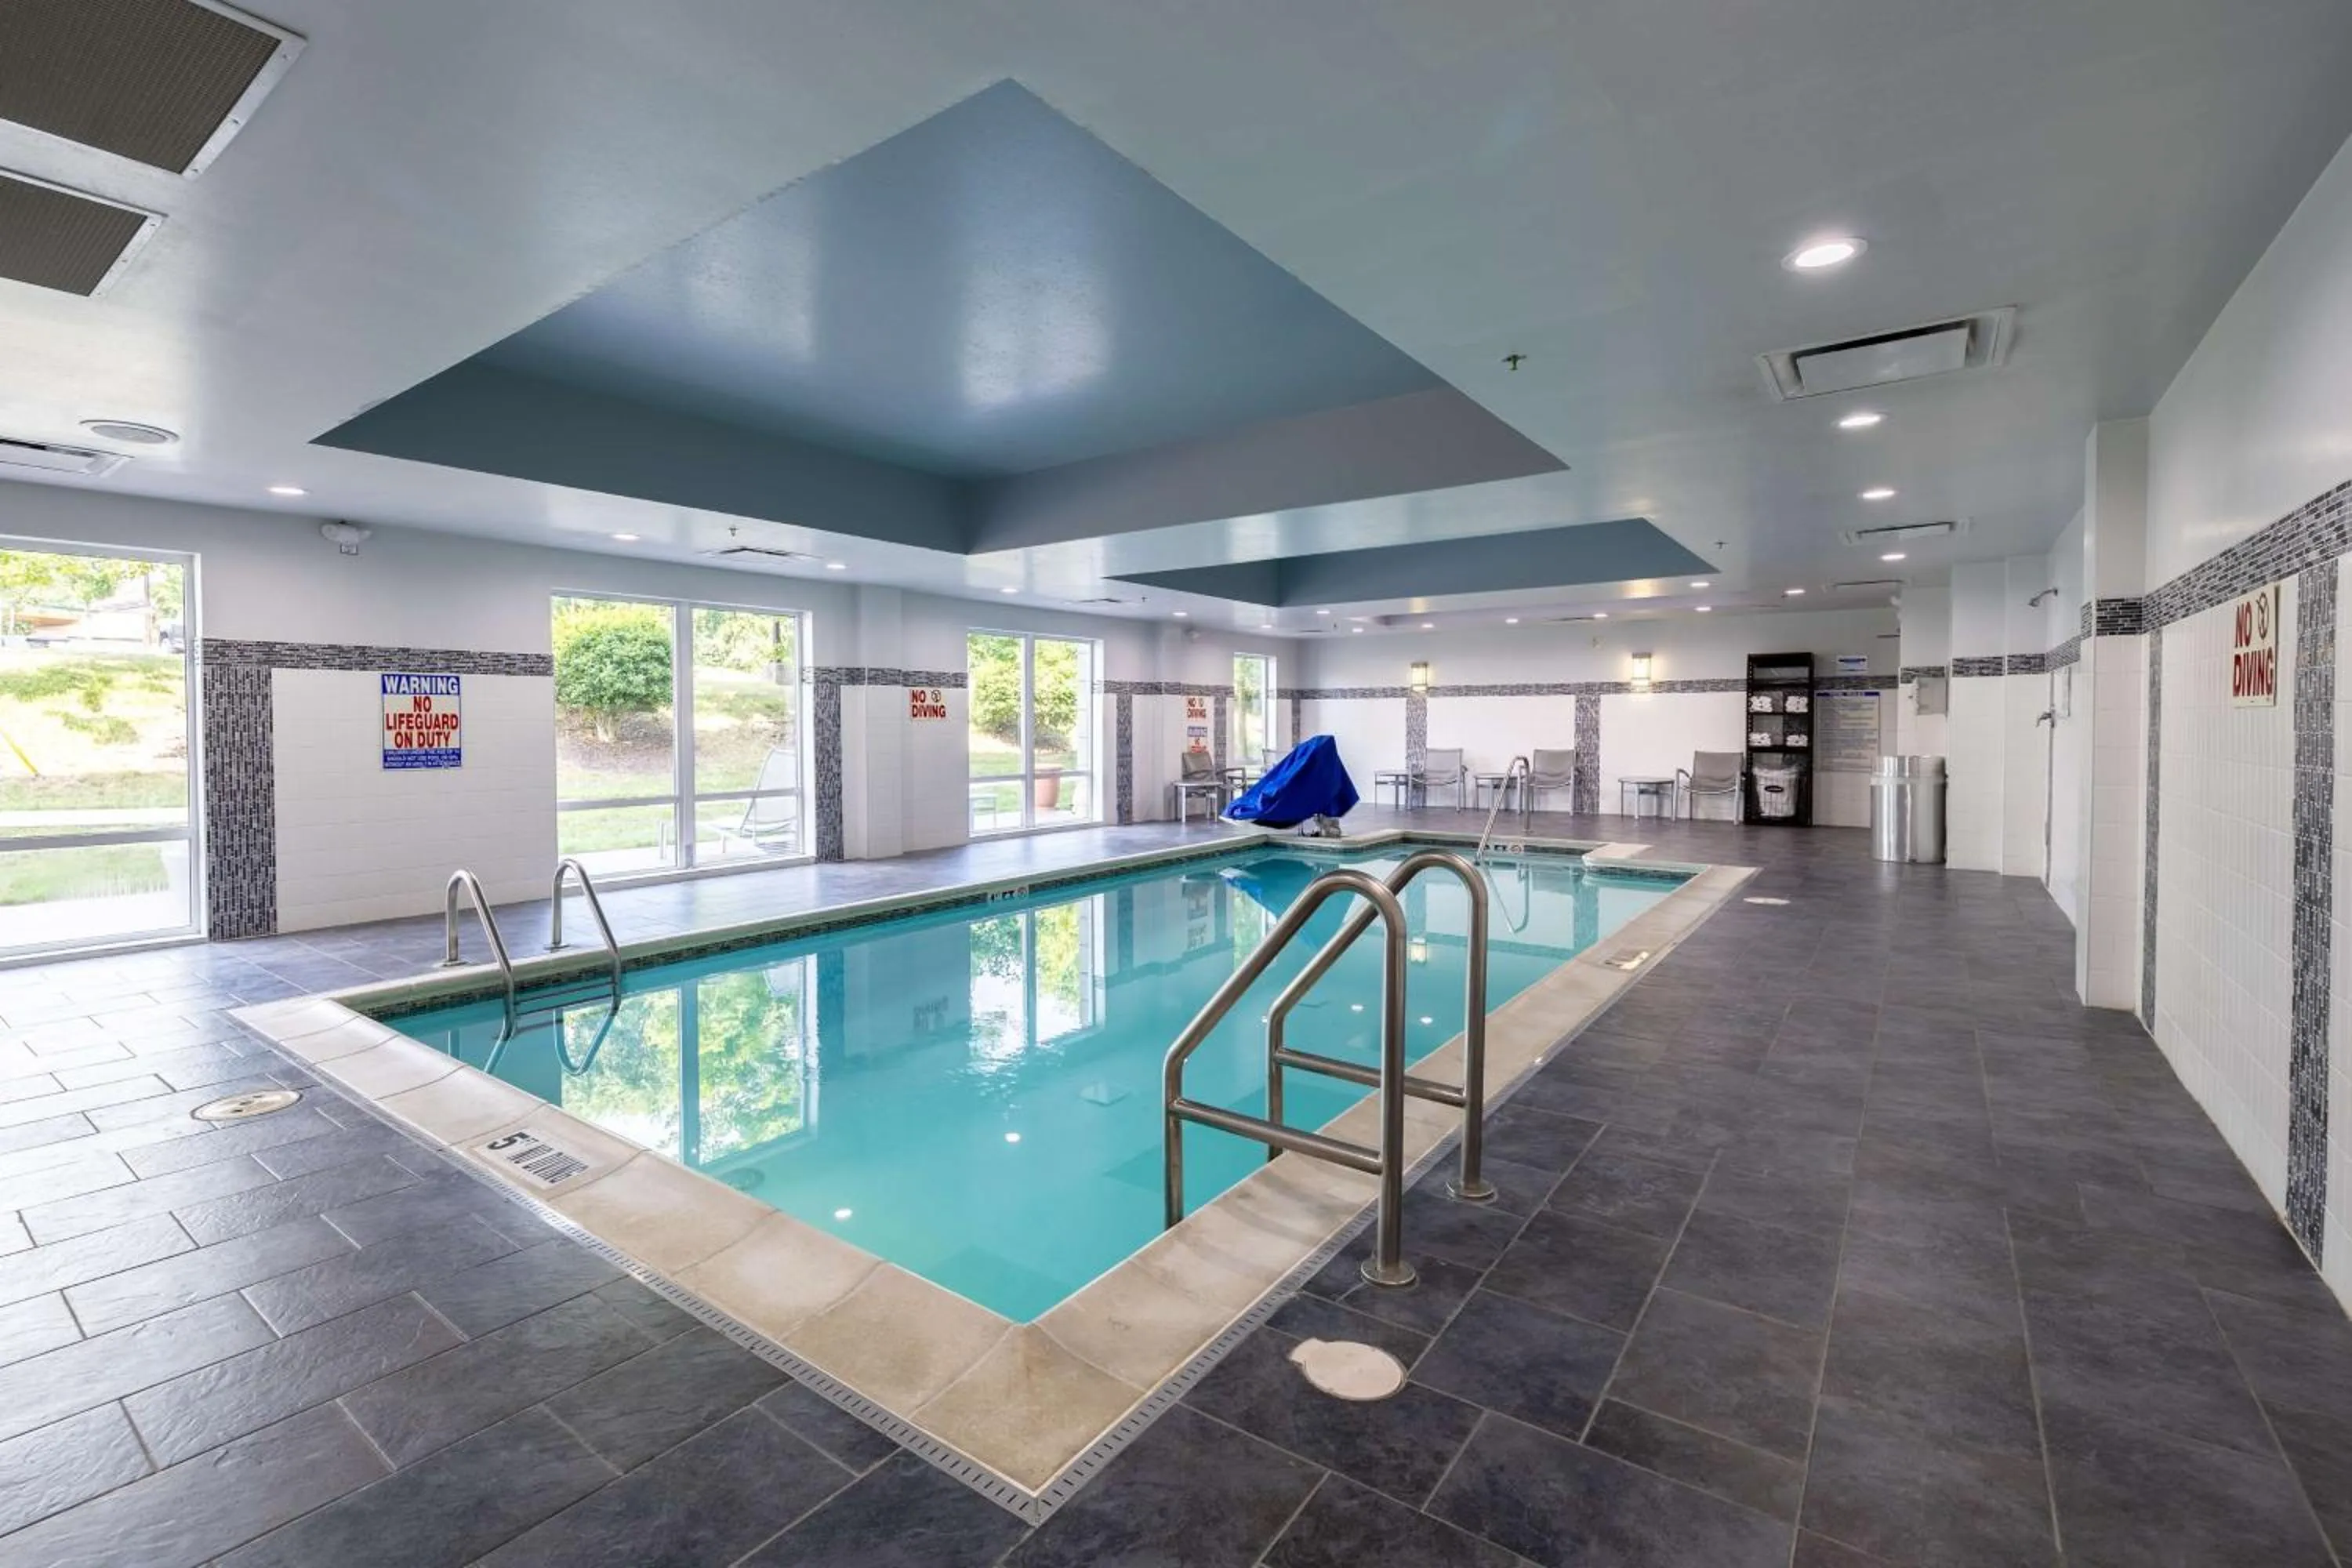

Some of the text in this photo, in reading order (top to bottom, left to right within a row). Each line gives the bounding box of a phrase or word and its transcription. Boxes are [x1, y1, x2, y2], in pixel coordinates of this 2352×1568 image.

[2235, 602, 2252, 648] NO
[2233, 648, 2273, 696] DIVING
[384, 676, 459, 694] WARNING
[413, 696, 432, 712] NO
[912, 690, 926, 702] NO
[912, 705, 946, 717] DIVING
[385, 713, 459, 730] LIFEGUARD
[394, 731, 450, 748] ON DUTY
[487, 1131, 530, 1150] 5
